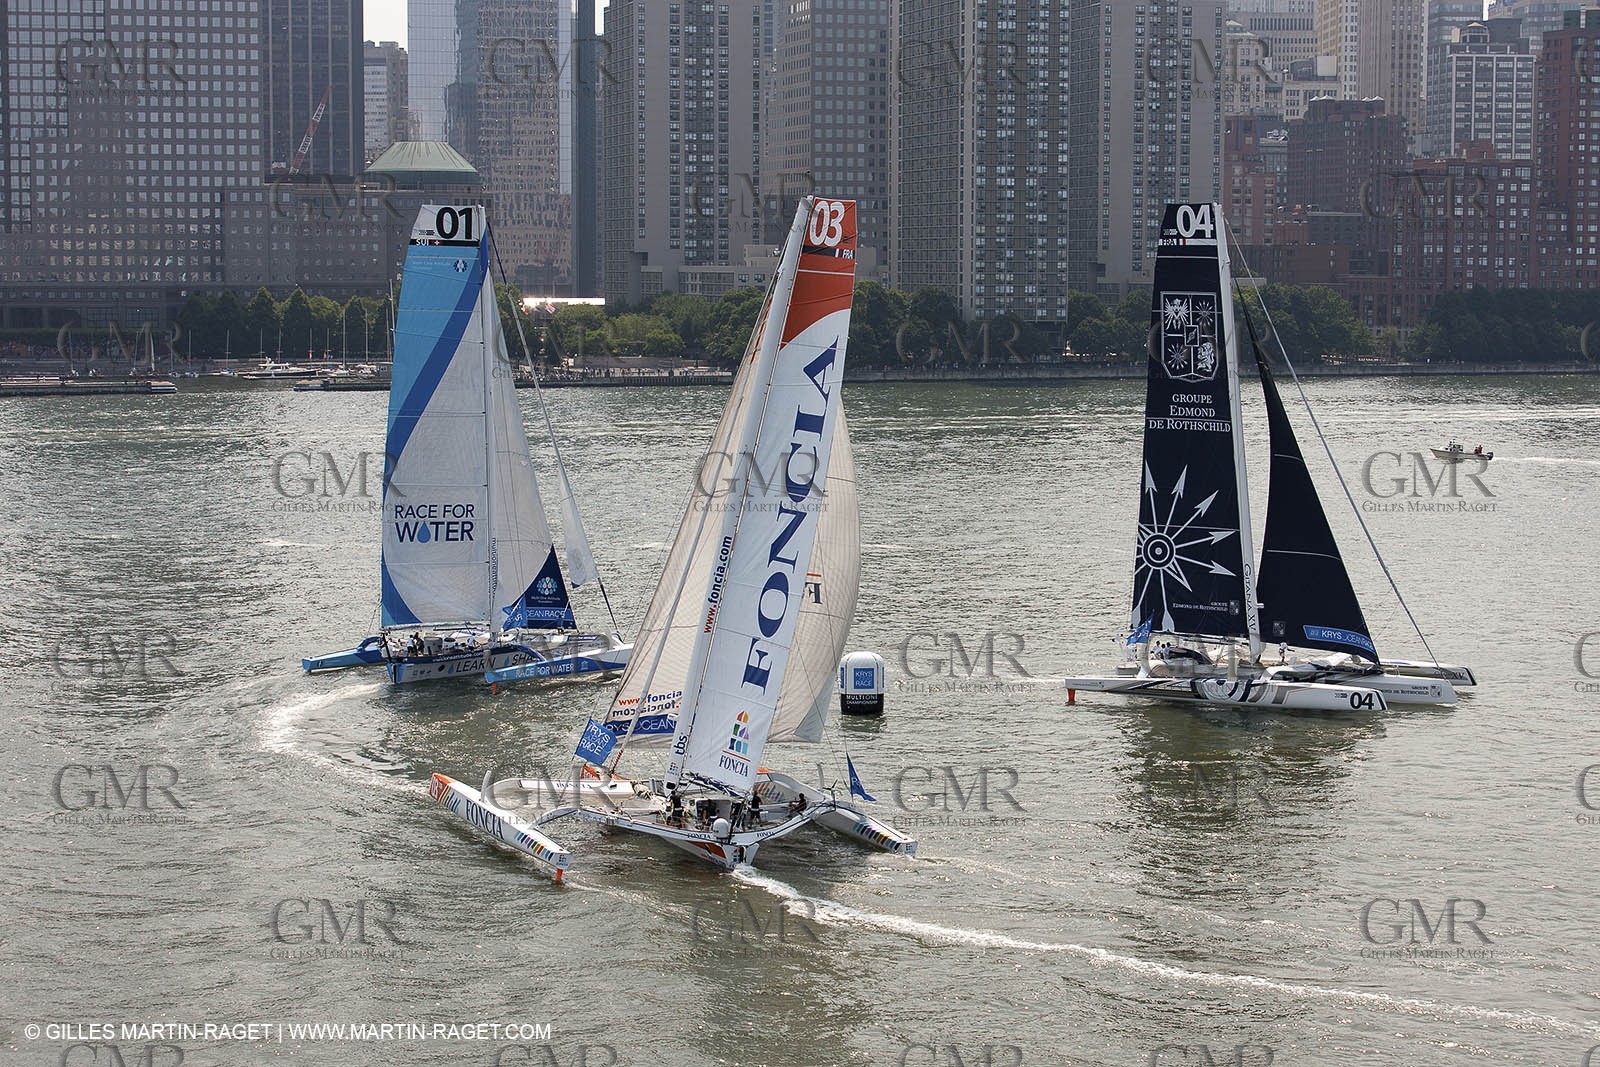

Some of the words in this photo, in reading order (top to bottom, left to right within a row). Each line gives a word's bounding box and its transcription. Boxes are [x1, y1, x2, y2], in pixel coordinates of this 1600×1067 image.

[436, 207, 472, 240] 01
[809, 201, 845, 247] 03
[1177, 205, 1213, 238] 04
[842, 249, 854, 259] FRA
[1172, 393, 1213, 404] GROUPE
[1169, 405, 1216, 418] EDMOND
[1149, 420, 1165, 429] DE
[1167, 418, 1231, 432] ROTHSCHILD
[394, 505, 438, 519] RACE
[443, 504, 475, 518] FOR
[741, 335, 840, 697] FONCIA
[702, 535, 732, 634] www.foncia.com
[1247, 614, 1256, 631] XV
[1322, 630, 1342, 640] KRYS
[456, 656, 497, 673] LEARN
[515, 668, 535, 677] RACE
[551, 663, 575, 673] WATER
[1350, 692, 1374, 710] 04
[579, 738, 604, 756] RACE
[673, 735, 688, 756] tbs
[719, 755, 749, 777] FONCIA
[466, 799, 504, 841] FONCIA
